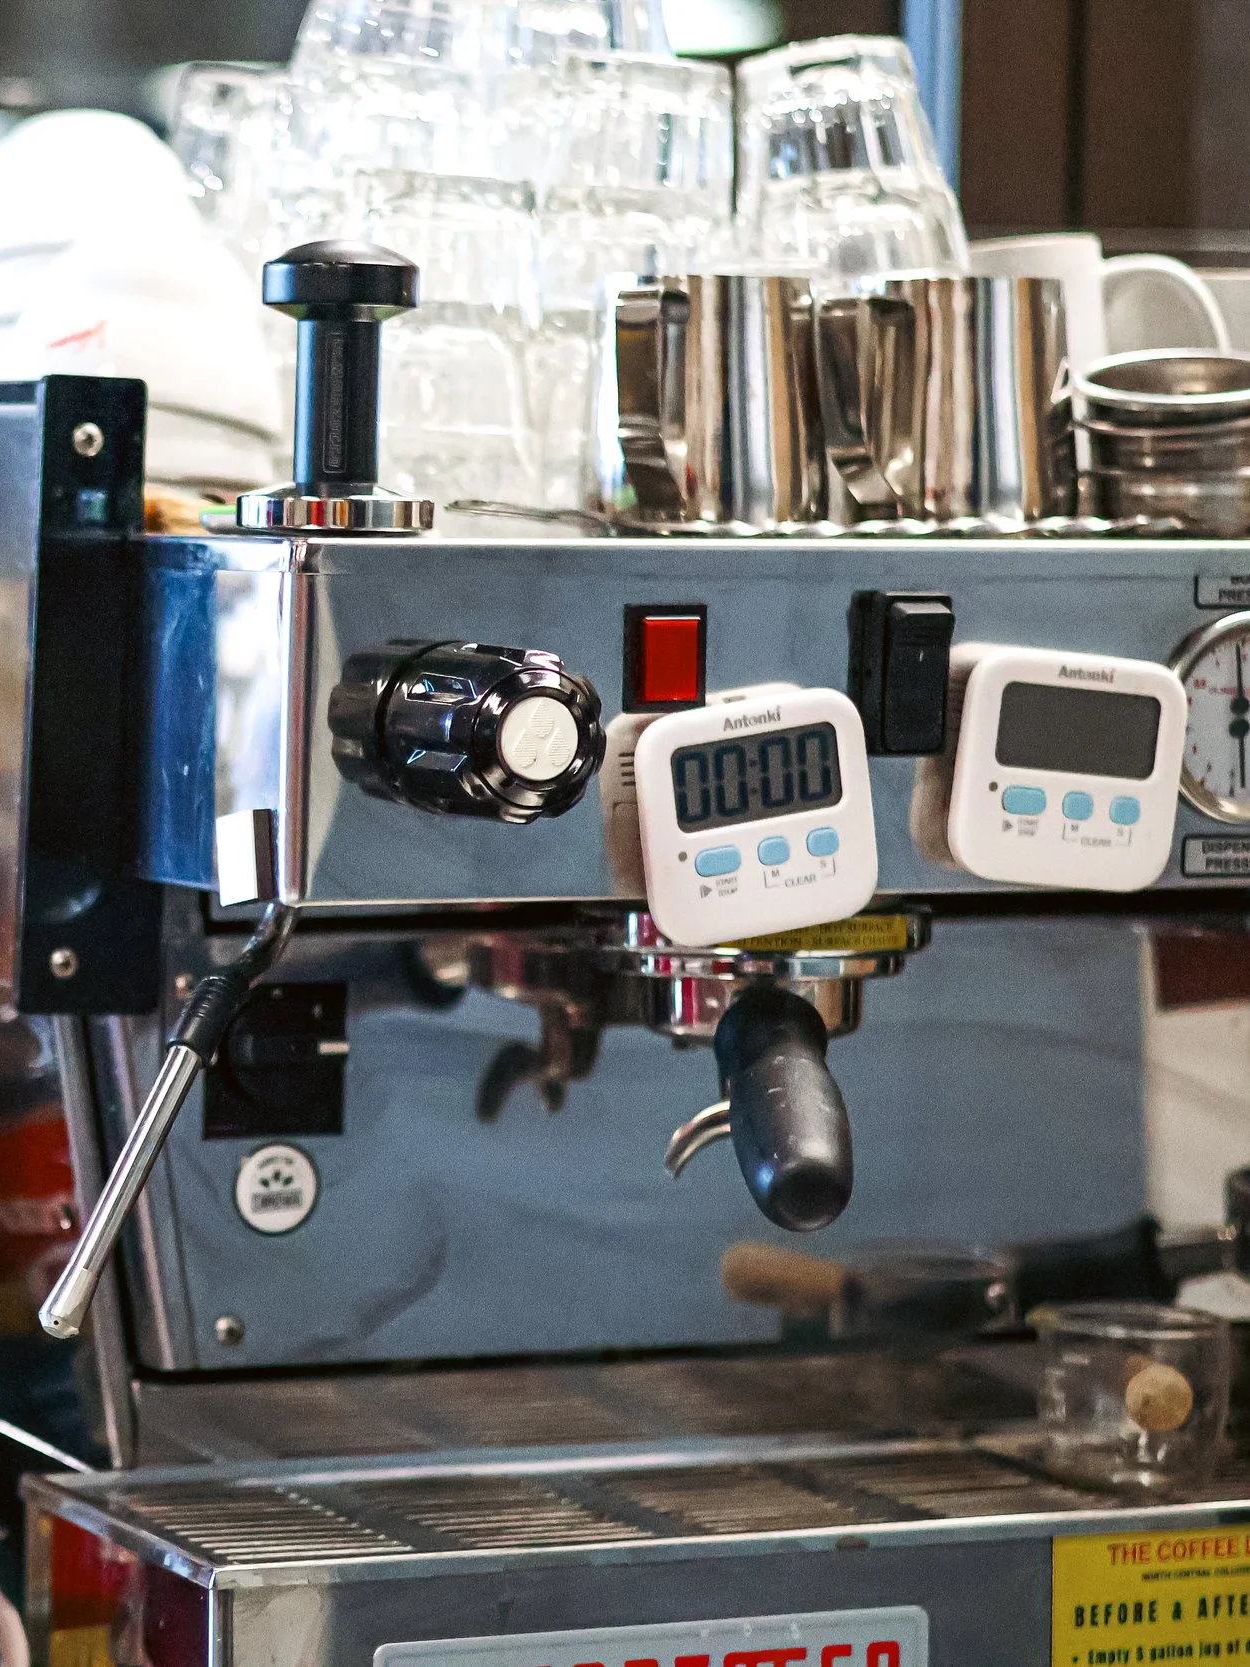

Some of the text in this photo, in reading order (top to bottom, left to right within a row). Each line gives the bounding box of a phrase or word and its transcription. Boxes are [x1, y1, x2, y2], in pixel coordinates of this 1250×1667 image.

[1058, 665, 1115, 683] Antonki
[723, 705, 781, 732] Antonki
[674, 731, 833, 823] 00:00
[771, 869, 780, 878] M
[784, 873, 817, 888] CLEAR
[1108, 1541, 1151, 1566] THE
[1157, 1535, 1239, 1563] COFFEE
[1075, 1600, 1157, 1627] BEFORE
[1088, 1648, 1130, 1665] Empty
[1150, 1643, 1193, 1661] gallon
